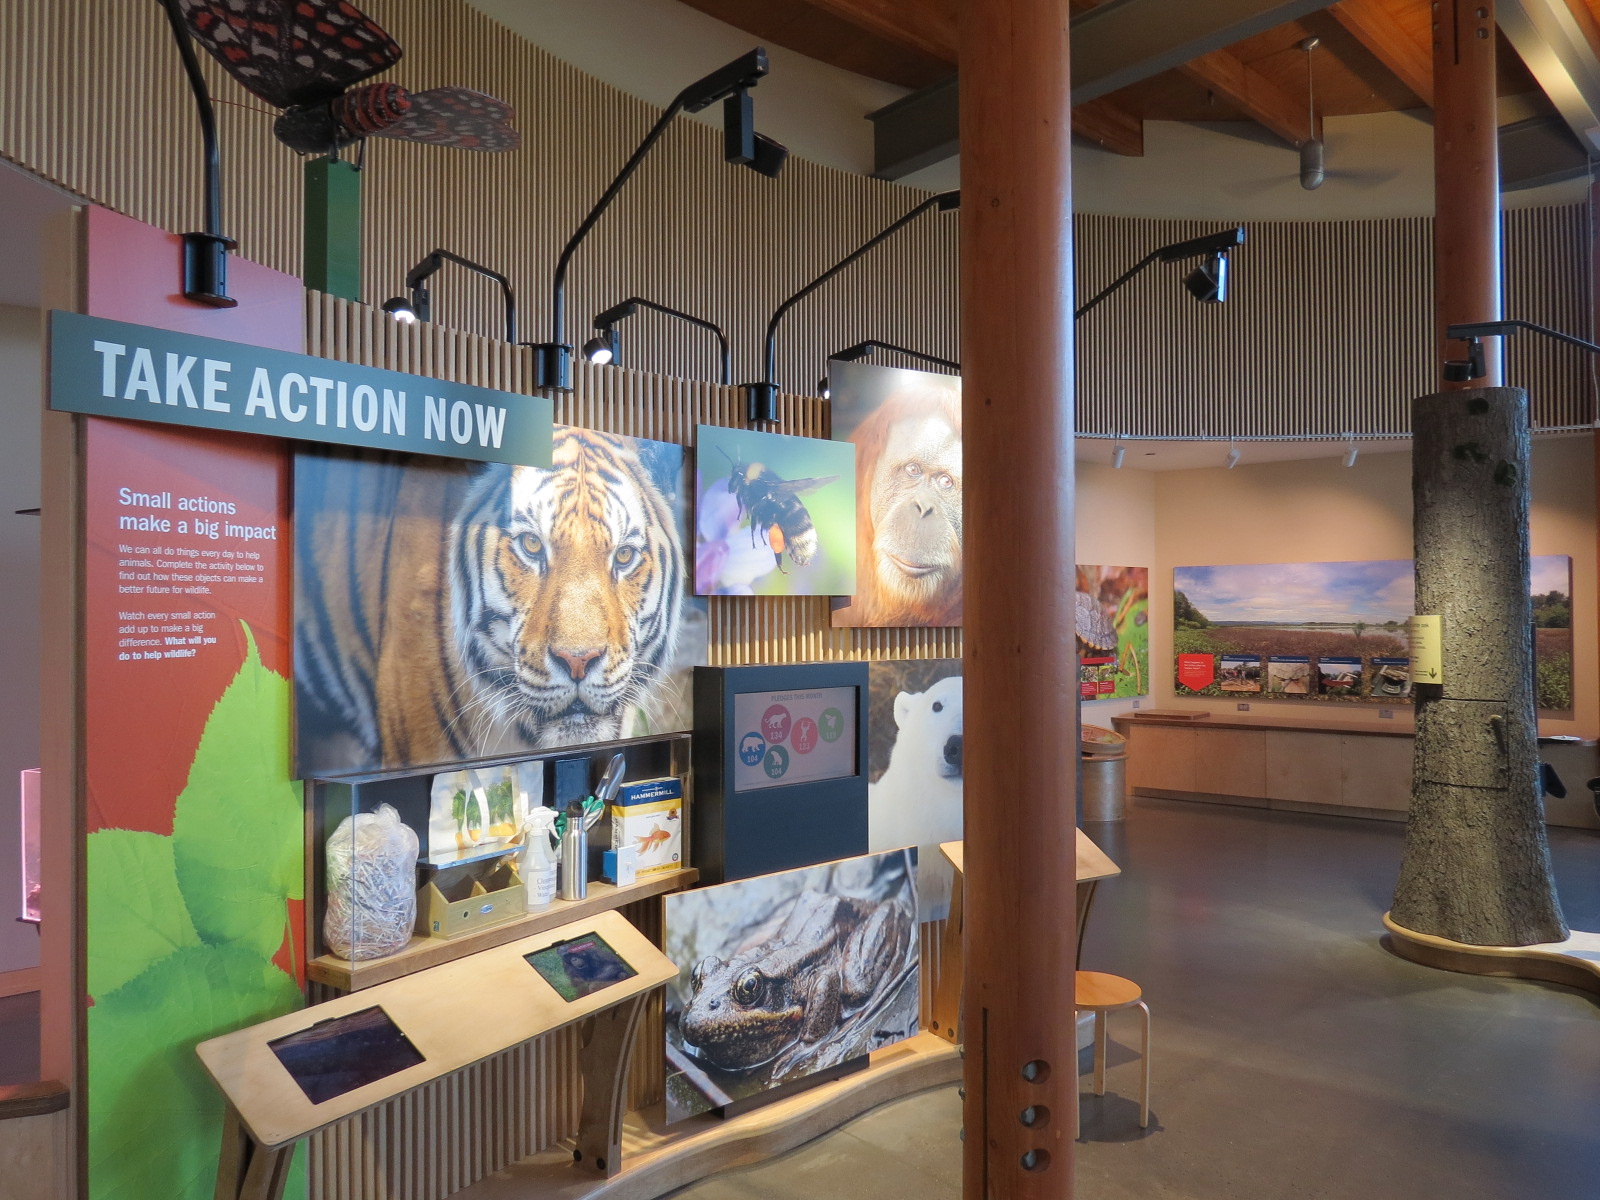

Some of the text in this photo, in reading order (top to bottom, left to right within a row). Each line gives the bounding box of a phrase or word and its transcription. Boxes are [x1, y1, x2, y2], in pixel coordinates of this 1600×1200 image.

[94, 340, 507, 449] TAKE ACTION NOW
[118, 487, 236, 516] Small actions
[119, 514, 277, 542] make a big impact
[119, 544, 133, 554] We
[152, 547, 162, 555] all
[164, 547, 174, 556] do
[176, 548, 200, 559] things
[201, 550, 220, 559] every
[222, 550, 235, 559] day
[236, 551, 244, 559] to
[245, 551, 260, 560] help
[119, 558, 264, 572] animals. Complete the activity below to
[119, 571, 135, 580] find
[137, 572, 151, 580] out
[153, 572, 169, 580] how
[171, 573, 193, 581] these
[195, 574, 221, 583] objects
[223, 575, 236, 583] can
[238, 575, 257, 583] make
[119, 584, 212, 595] better future for wildlife.
[118, 611, 216, 622] Watch every small action
[119, 625, 135, 634] add
[138, 626, 148, 635] up
[150, 625, 159, 633] to
[161, 624, 182, 632] make
[192, 623, 204, 634] big
[118, 636, 217, 647] difference. What will you
[118, 648, 196, 660] do to help wildlife?
[630, 789, 674, 801] HAMMERMILL
